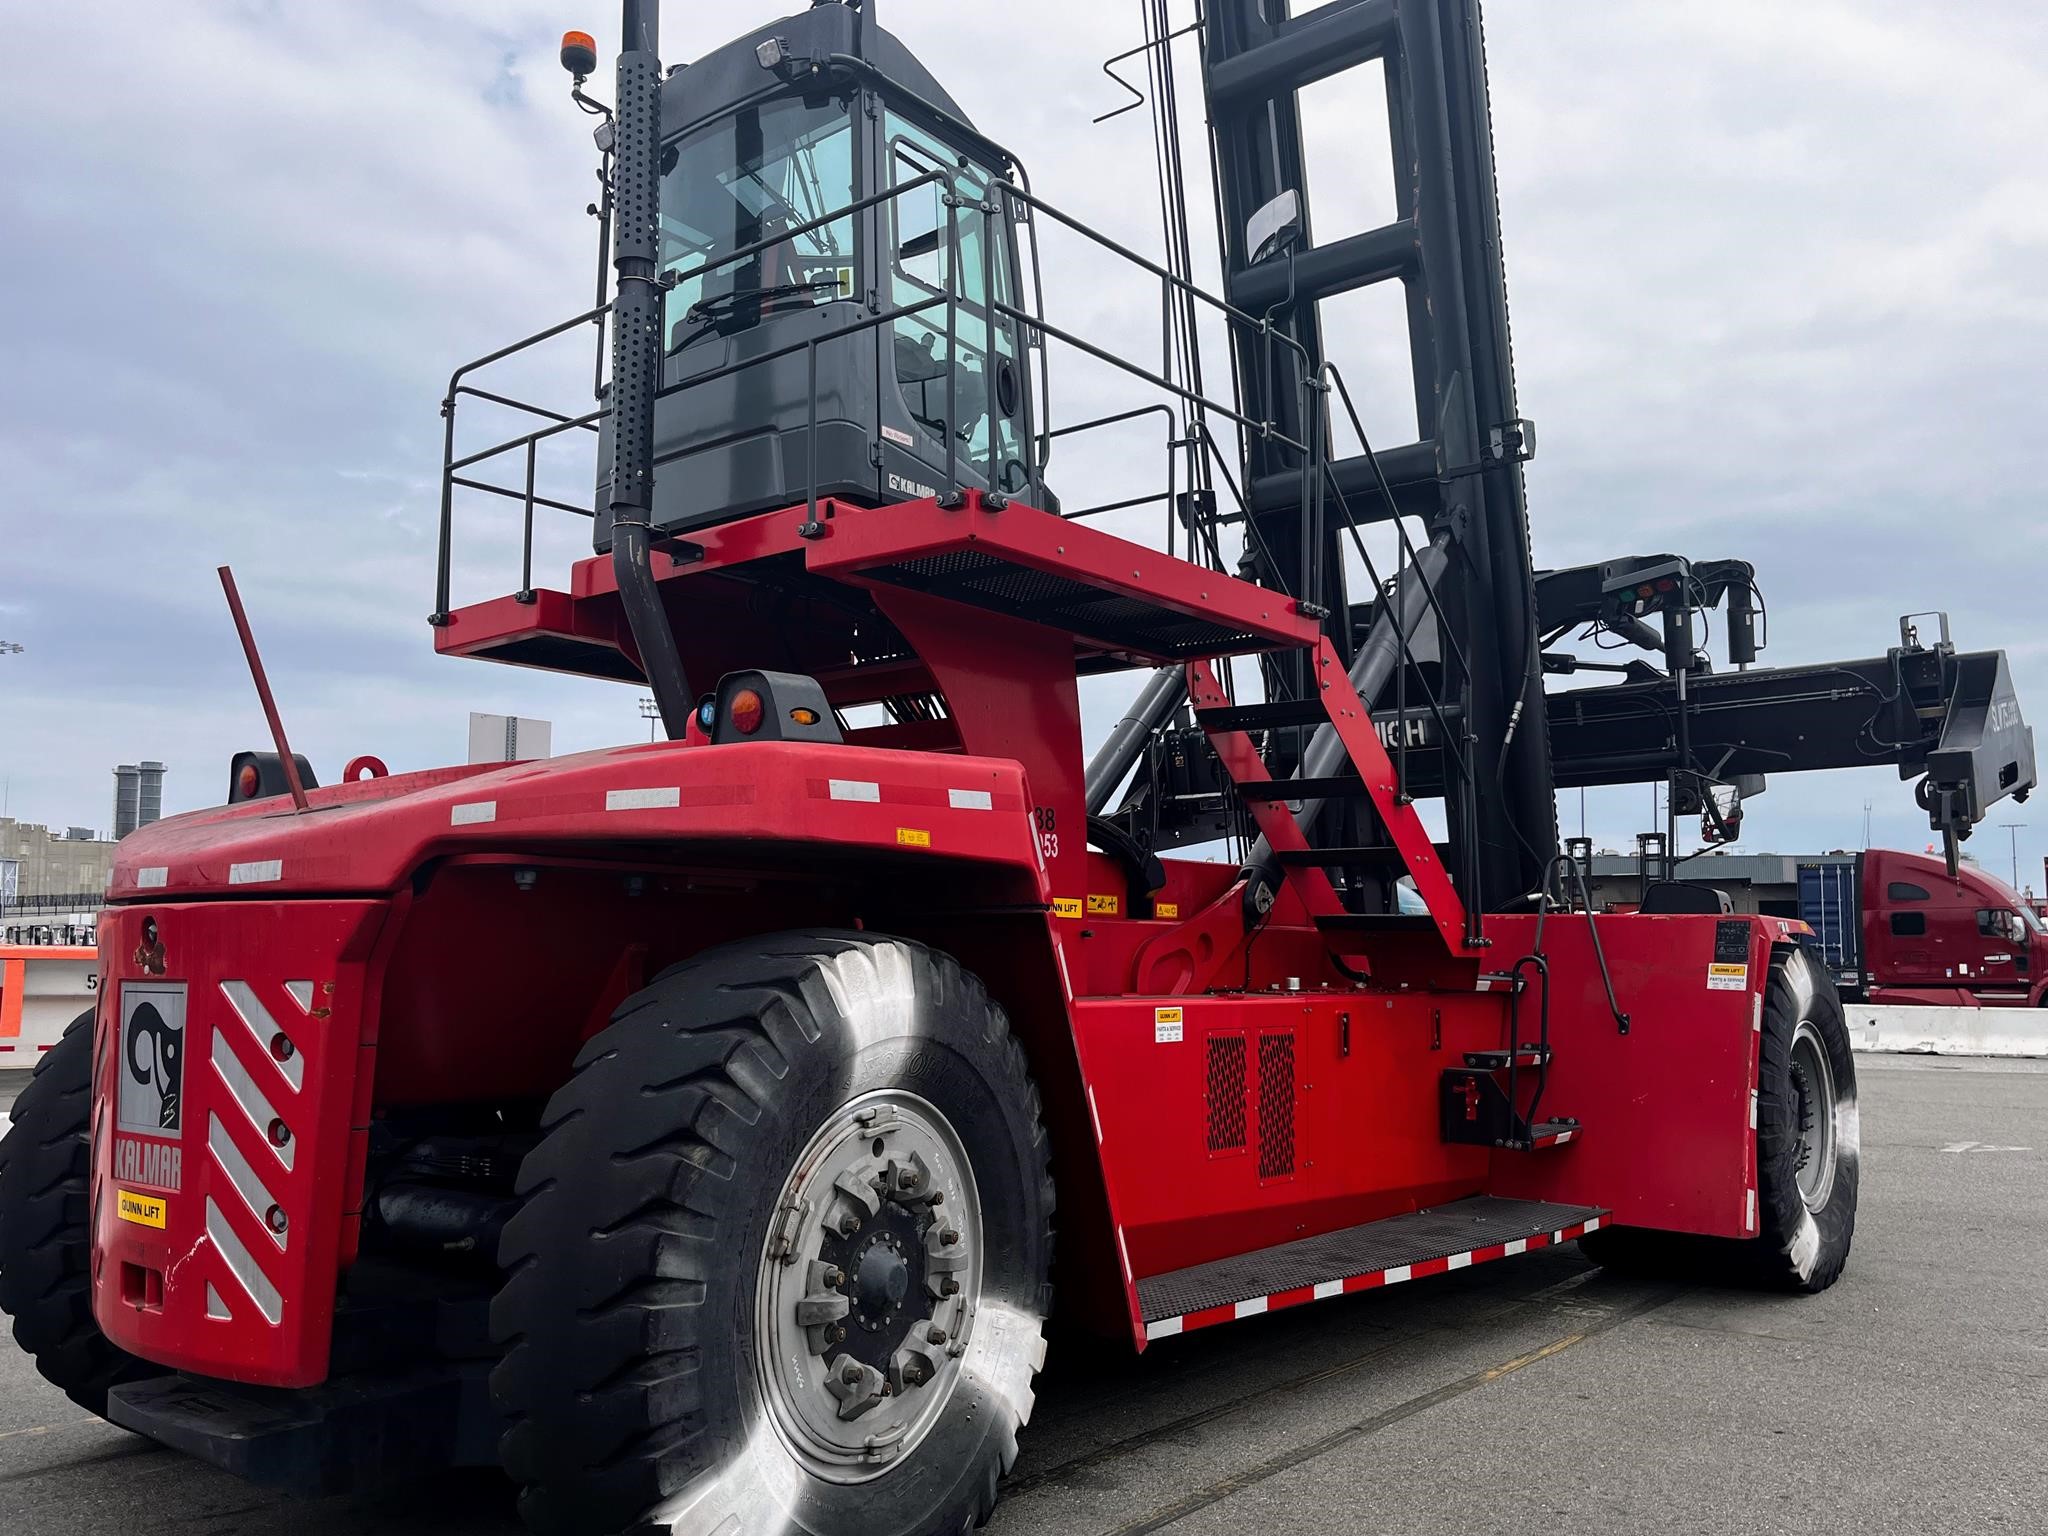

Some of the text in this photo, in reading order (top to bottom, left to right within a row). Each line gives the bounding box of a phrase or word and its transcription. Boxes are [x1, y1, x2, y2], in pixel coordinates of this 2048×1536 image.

[900, 477, 936, 499] KALMAR
[1039, 833, 1059, 858] 53
[1064, 904, 1078, 913] LIFT
[87, 974, 98, 990] 5
[114, 1138, 182, 1190] KALMAR
[121, 1199, 161, 1219] QUINN LIFT
